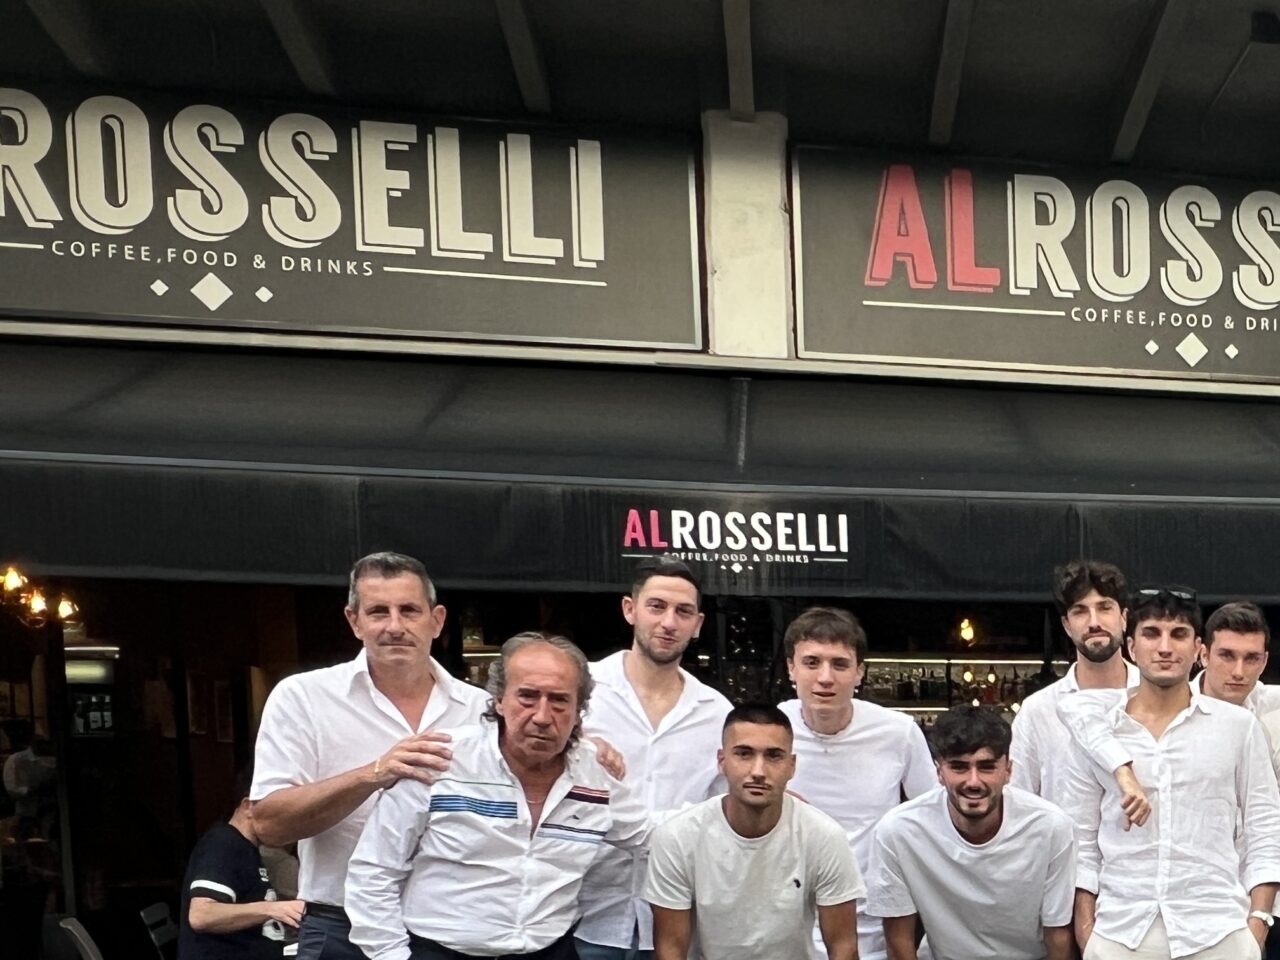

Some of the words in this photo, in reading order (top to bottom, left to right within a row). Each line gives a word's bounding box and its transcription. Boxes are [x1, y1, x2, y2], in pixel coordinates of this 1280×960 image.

[252, 254, 267, 269] &
[281, 255, 373, 276] DRINKS
[1224, 315, 1235, 330] &
